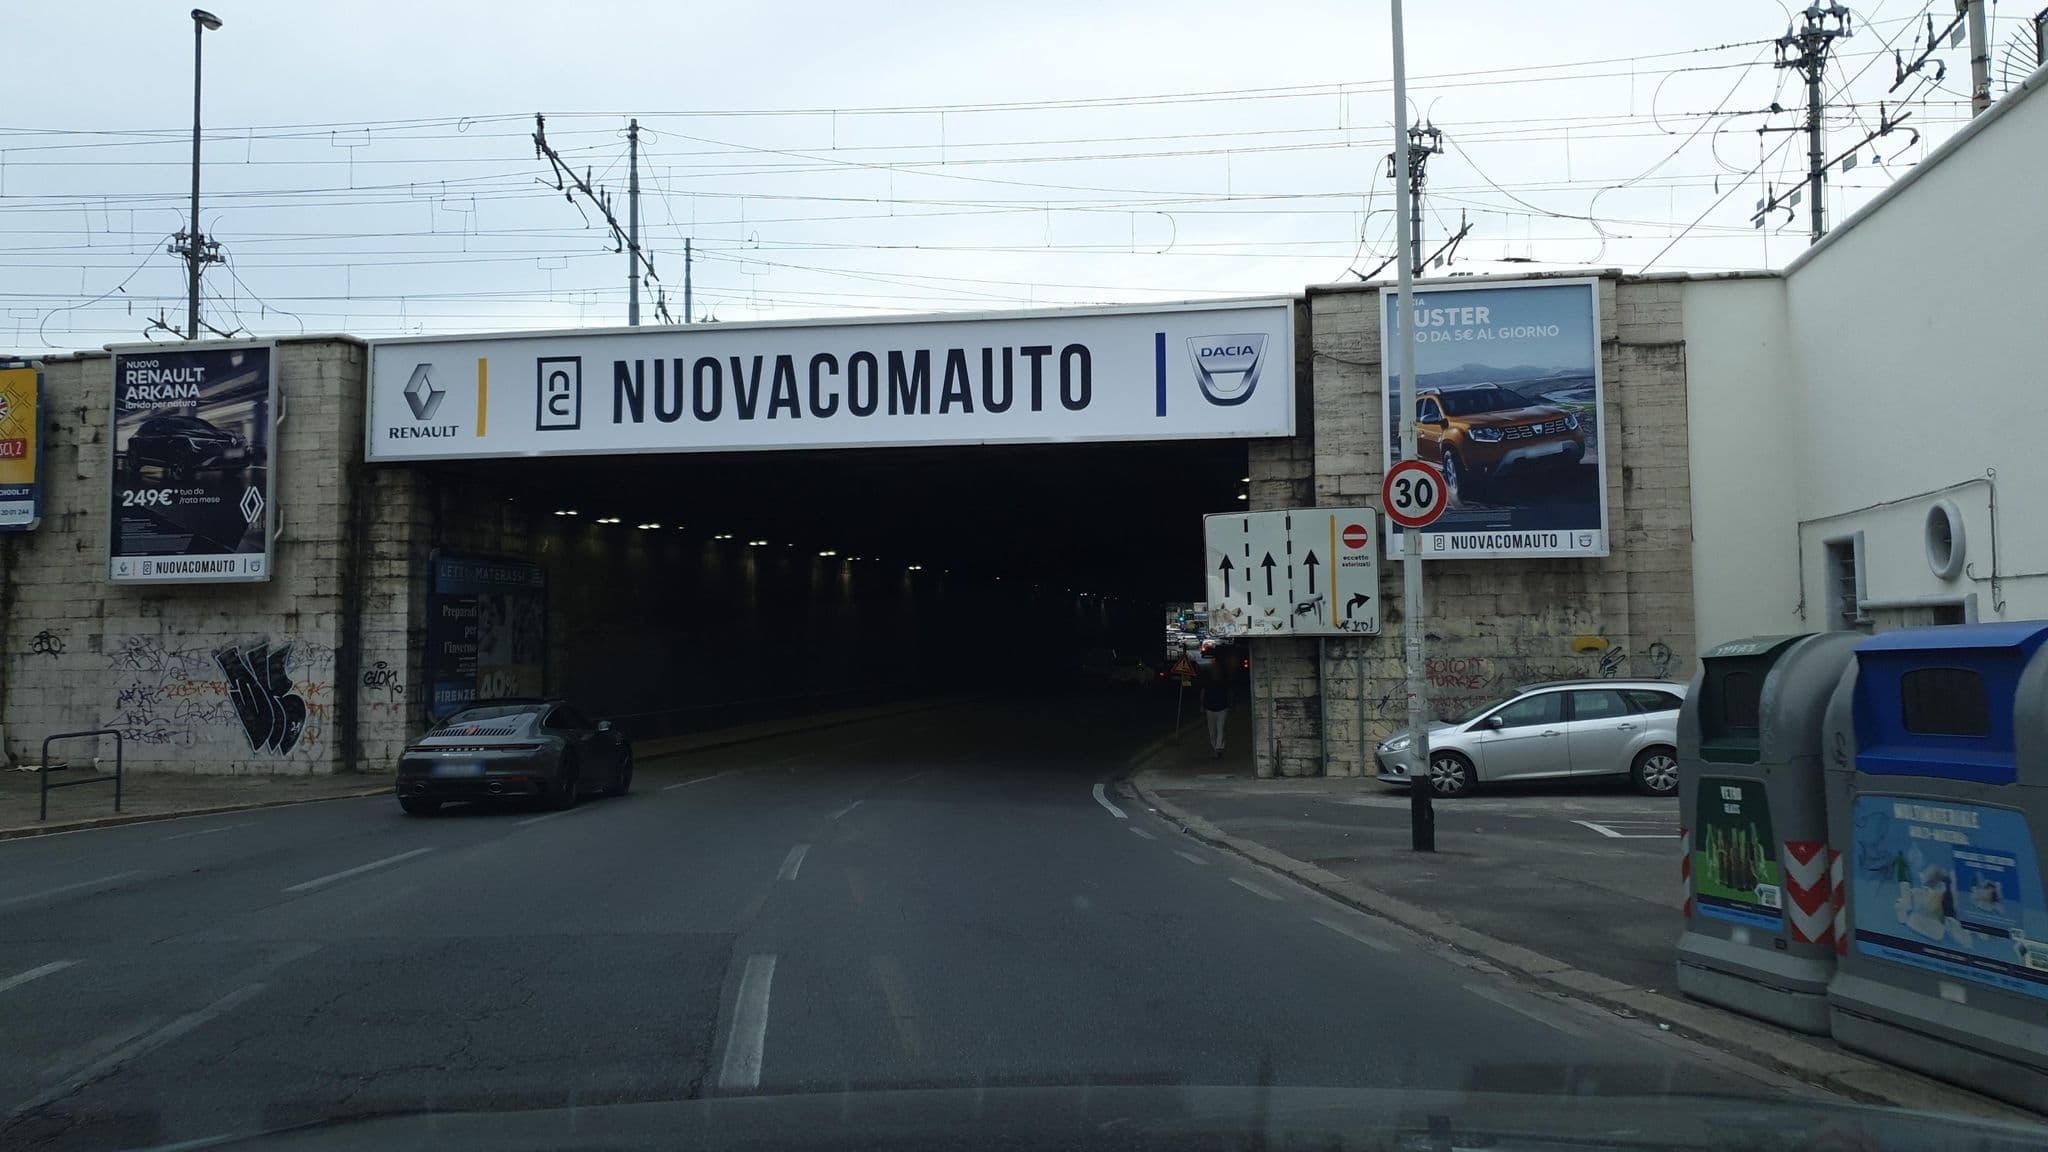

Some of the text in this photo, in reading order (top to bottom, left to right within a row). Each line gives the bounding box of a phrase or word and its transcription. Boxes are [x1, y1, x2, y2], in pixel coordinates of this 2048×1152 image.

[1397, 306, 1490, 329] USTER
[1431, 331, 1451, 343] DA
[1454, 329, 1474, 342] 5€
[1477, 328, 1495, 340] AL
[1499, 324, 1559, 339] GIORNO
[1200, 345, 1255, 358] DACIA
[126, 360, 159, 369] NUOVO
[126, 367, 205, 385] RENAULT
[613, 343, 1092, 424] NUOVACOMAUTO
[125, 383, 201, 401] ARKANA
[125, 400, 151, 409] ibrido
[167, 400, 197, 408] natura
[389, 425, 459, 439] RENAULT
[1395, 477, 1434, 509] 30
[1451, 533, 1558, 550] NUOVACOMAUTO
[155, 560, 236, 574] NUOVACOMAUTO
[434, 688, 476, 704] FIRENZE
